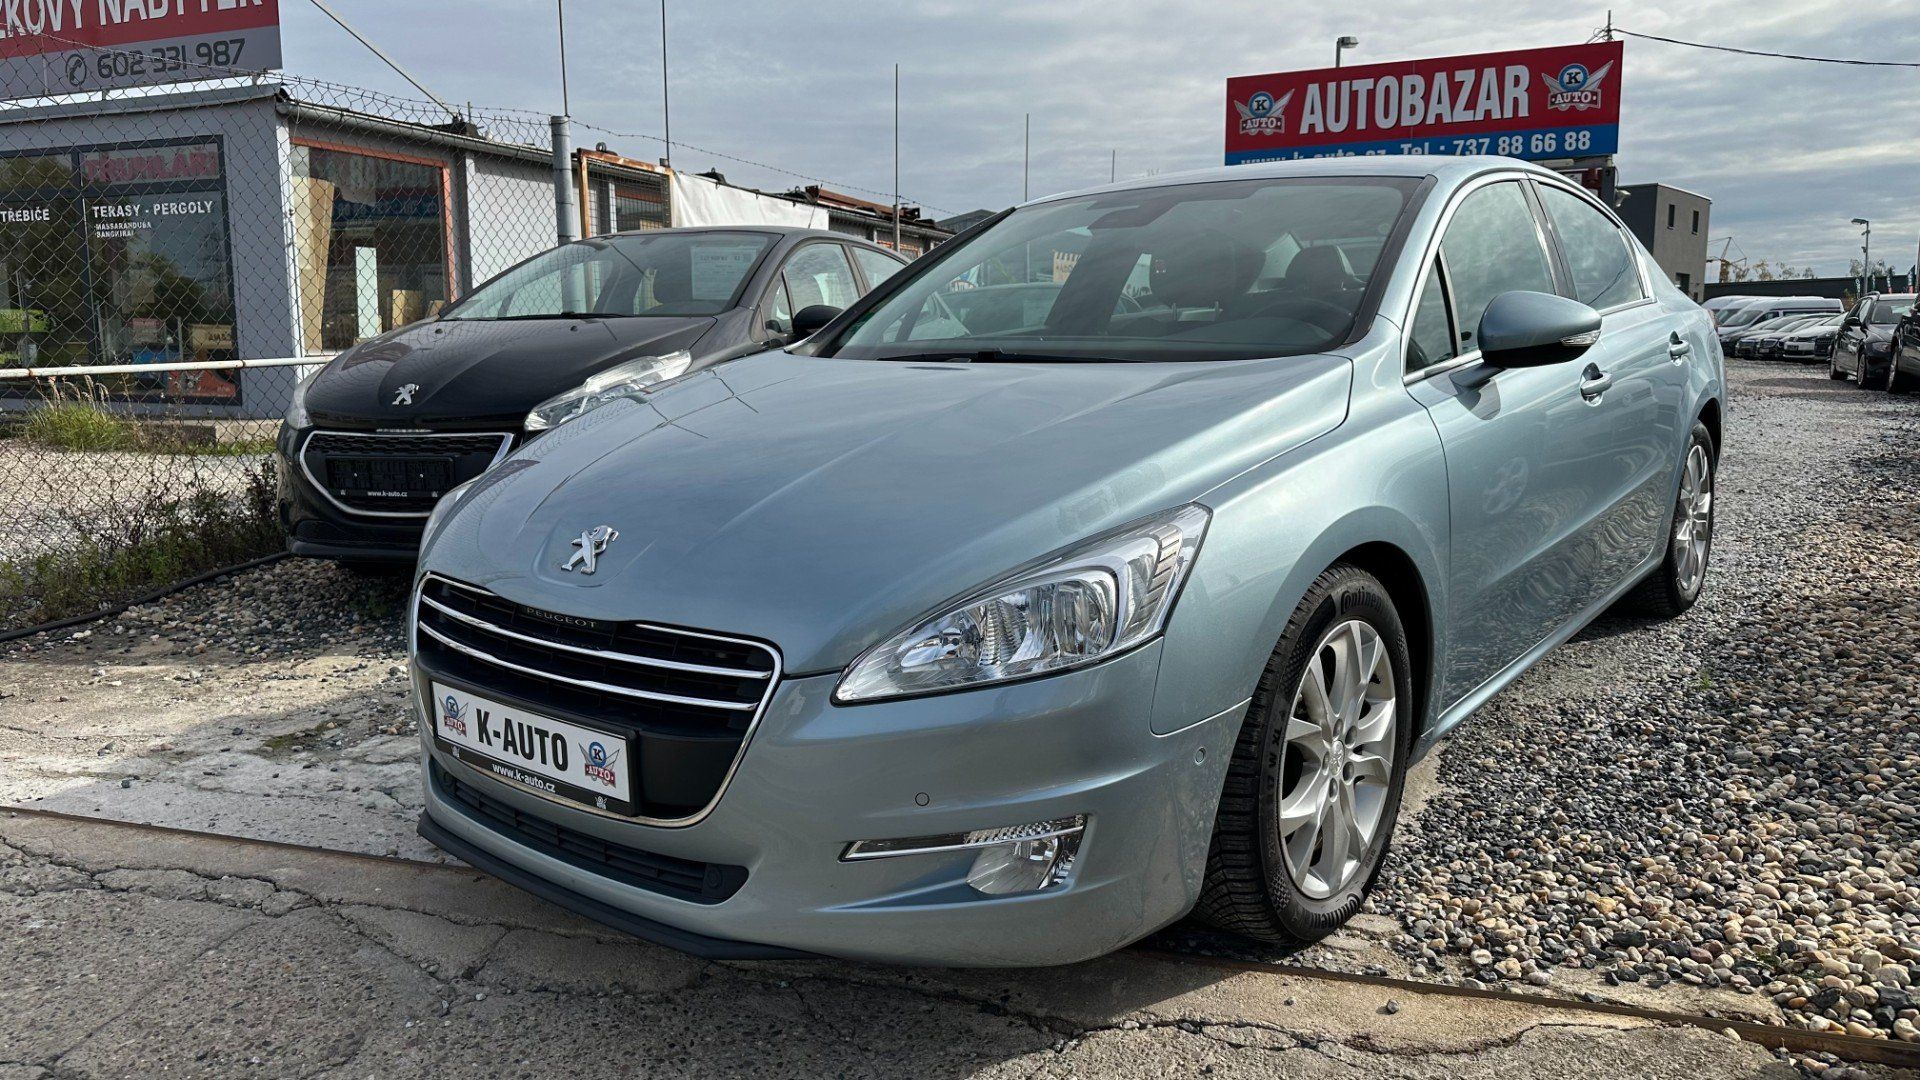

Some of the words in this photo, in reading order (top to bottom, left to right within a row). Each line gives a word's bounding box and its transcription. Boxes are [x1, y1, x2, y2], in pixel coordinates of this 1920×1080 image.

[97, 51, 147, 78] 602
[152, 45, 187, 73] 331
[196, 38, 246, 66] 987
[1566, 71, 1581, 84] K
[1254, 99, 1268, 111] K
[1299, 64, 1530, 135] AUTOBAZAR
[1554, 91, 1592, 104] AUTO
[1245, 117, 1277, 129] AUTO
[1452, 138, 1490, 156] 737
[1498, 135, 1523, 155] 88
[1530, 132, 1557, 153] 66
[1564, 130, 1592, 151] 88
[0, 206, 51, 222] TŘEBIČE
[92, 204, 141, 218] TERASY
[153, 200, 213, 216] PERGOLY
[526, 607, 597, 628] PEUGEOT
[476, 708, 568, 772] K-AUTO
[592, 748, 603, 761] K
[492, 763, 556, 793] www.k-auto.cz
[588, 766, 611, 781] AUTO
